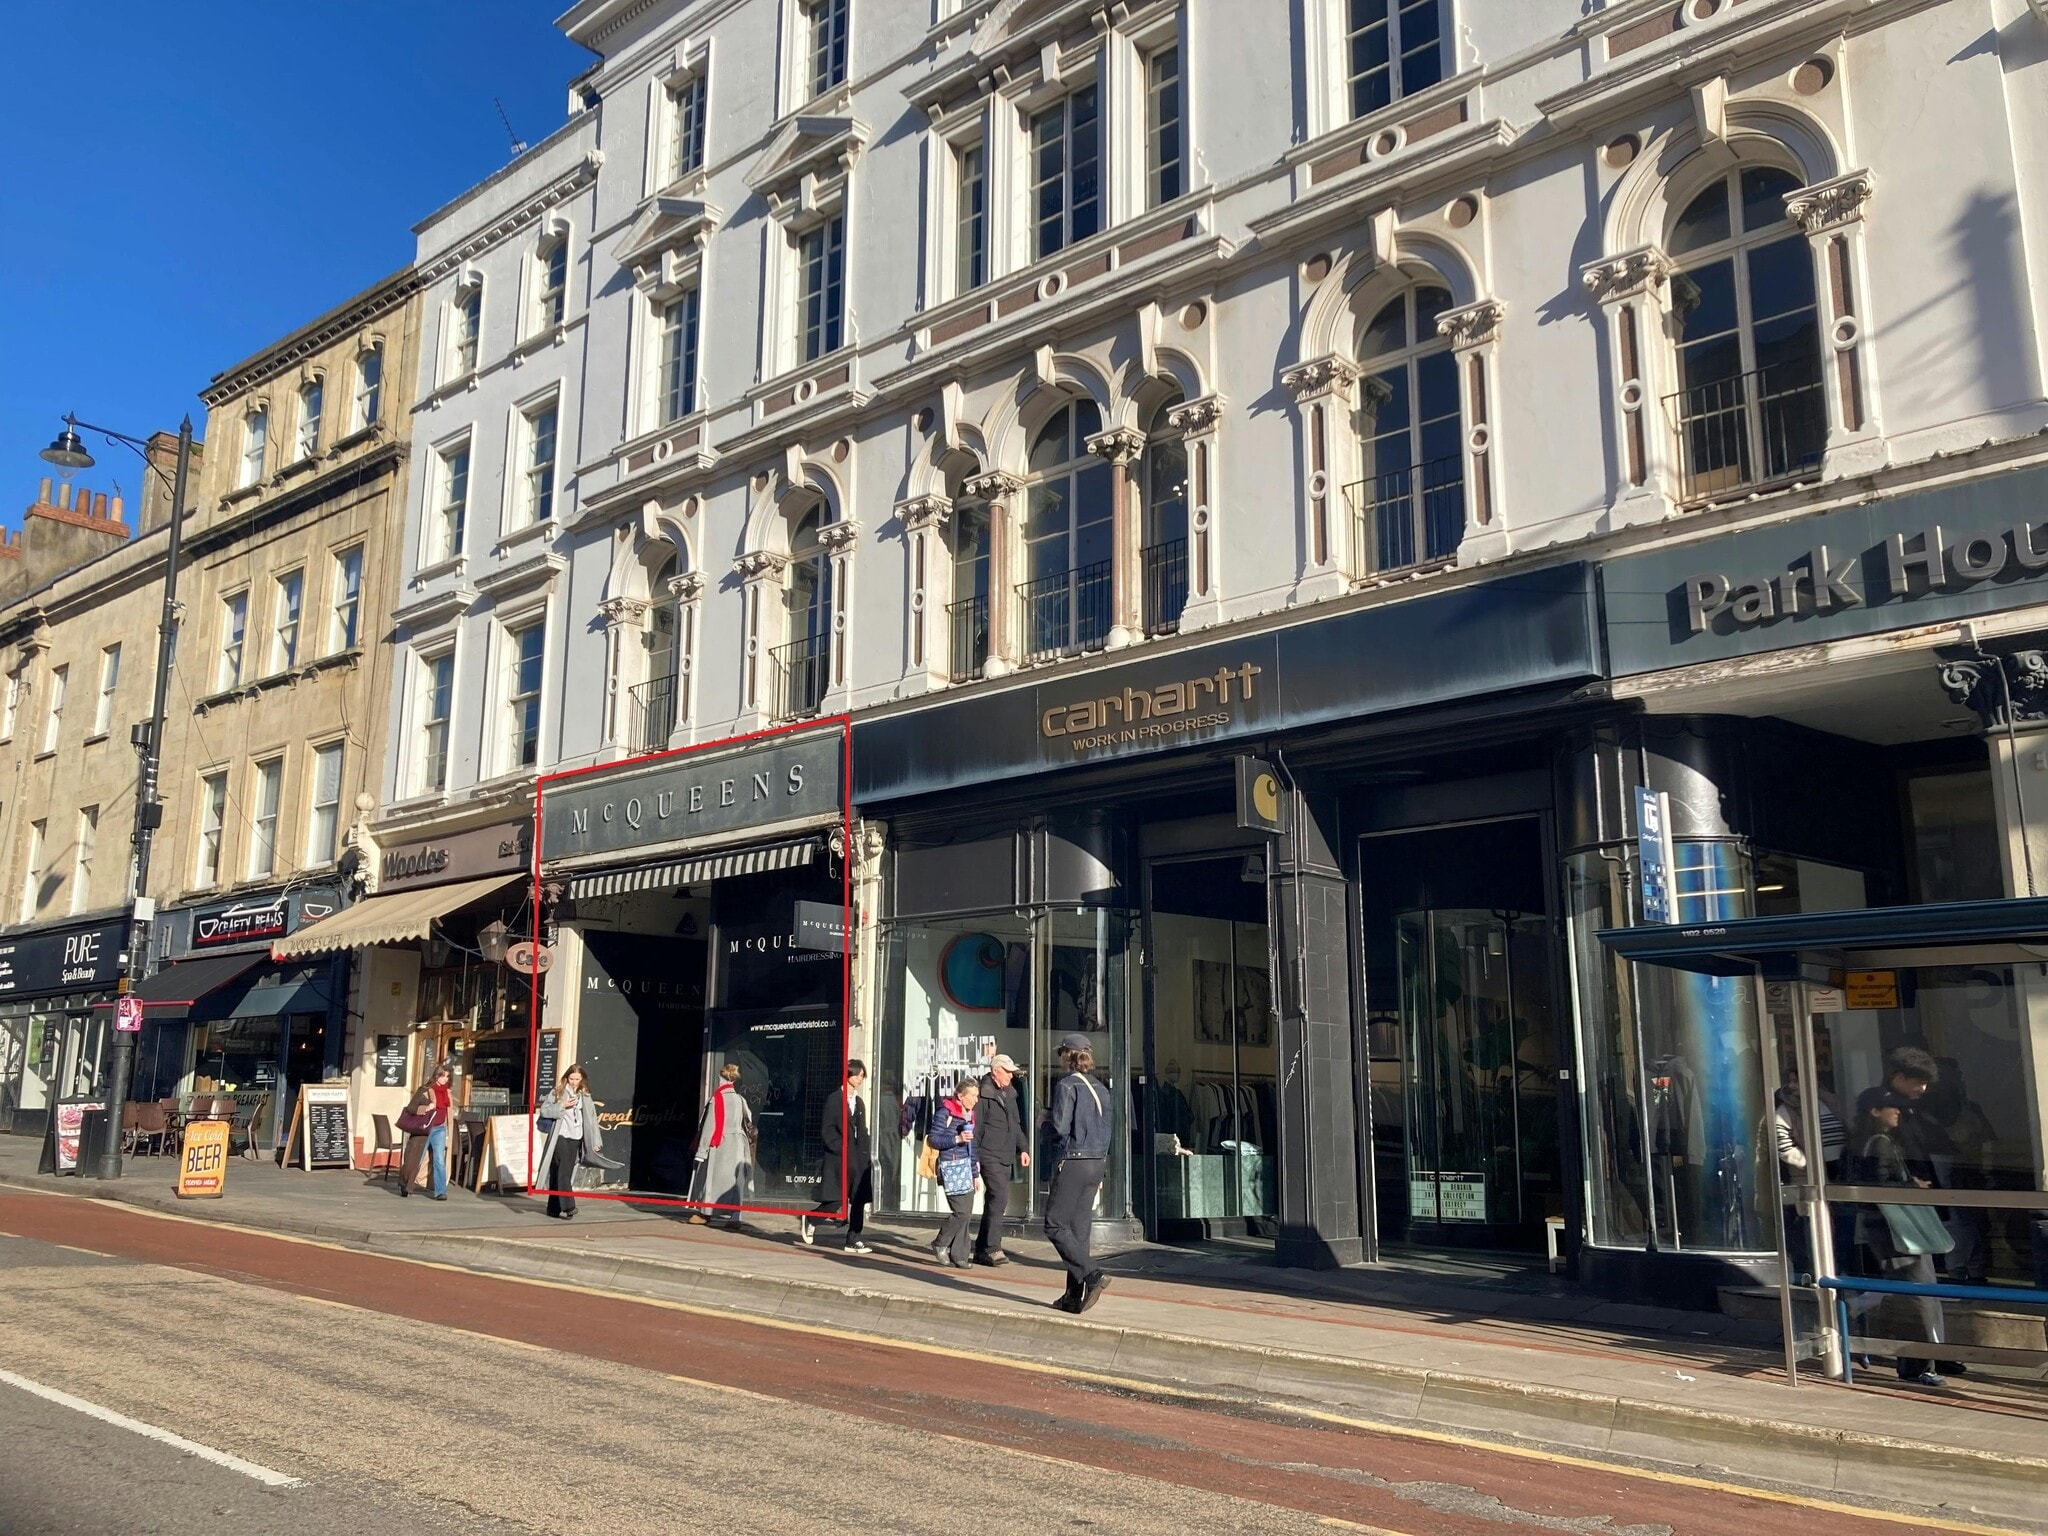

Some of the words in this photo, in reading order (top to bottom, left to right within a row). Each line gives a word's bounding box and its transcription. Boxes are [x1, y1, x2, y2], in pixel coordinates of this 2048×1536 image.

[1687, 545, 1863, 632] Park
[1042, 662, 1262, 737] carhartt
[1073, 732, 1117, 750] WORK
[1121, 728, 1136, 742] IN
[1139, 712, 1230, 738] PROGRESS
[384, 846, 449, 877] Woodes
[218, 915, 251, 934] CRAFTY
[255, 911, 284, 931] BEANS
[1703, 928, 1726, 936] 0520
[64, 933, 101, 965] PURE
[730, 934, 797, 953] McQUE
[190, 1130, 202, 1141] Ice
[204, 1130, 224, 1142] Cold
[187, 1143, 222, 1173] BEER
